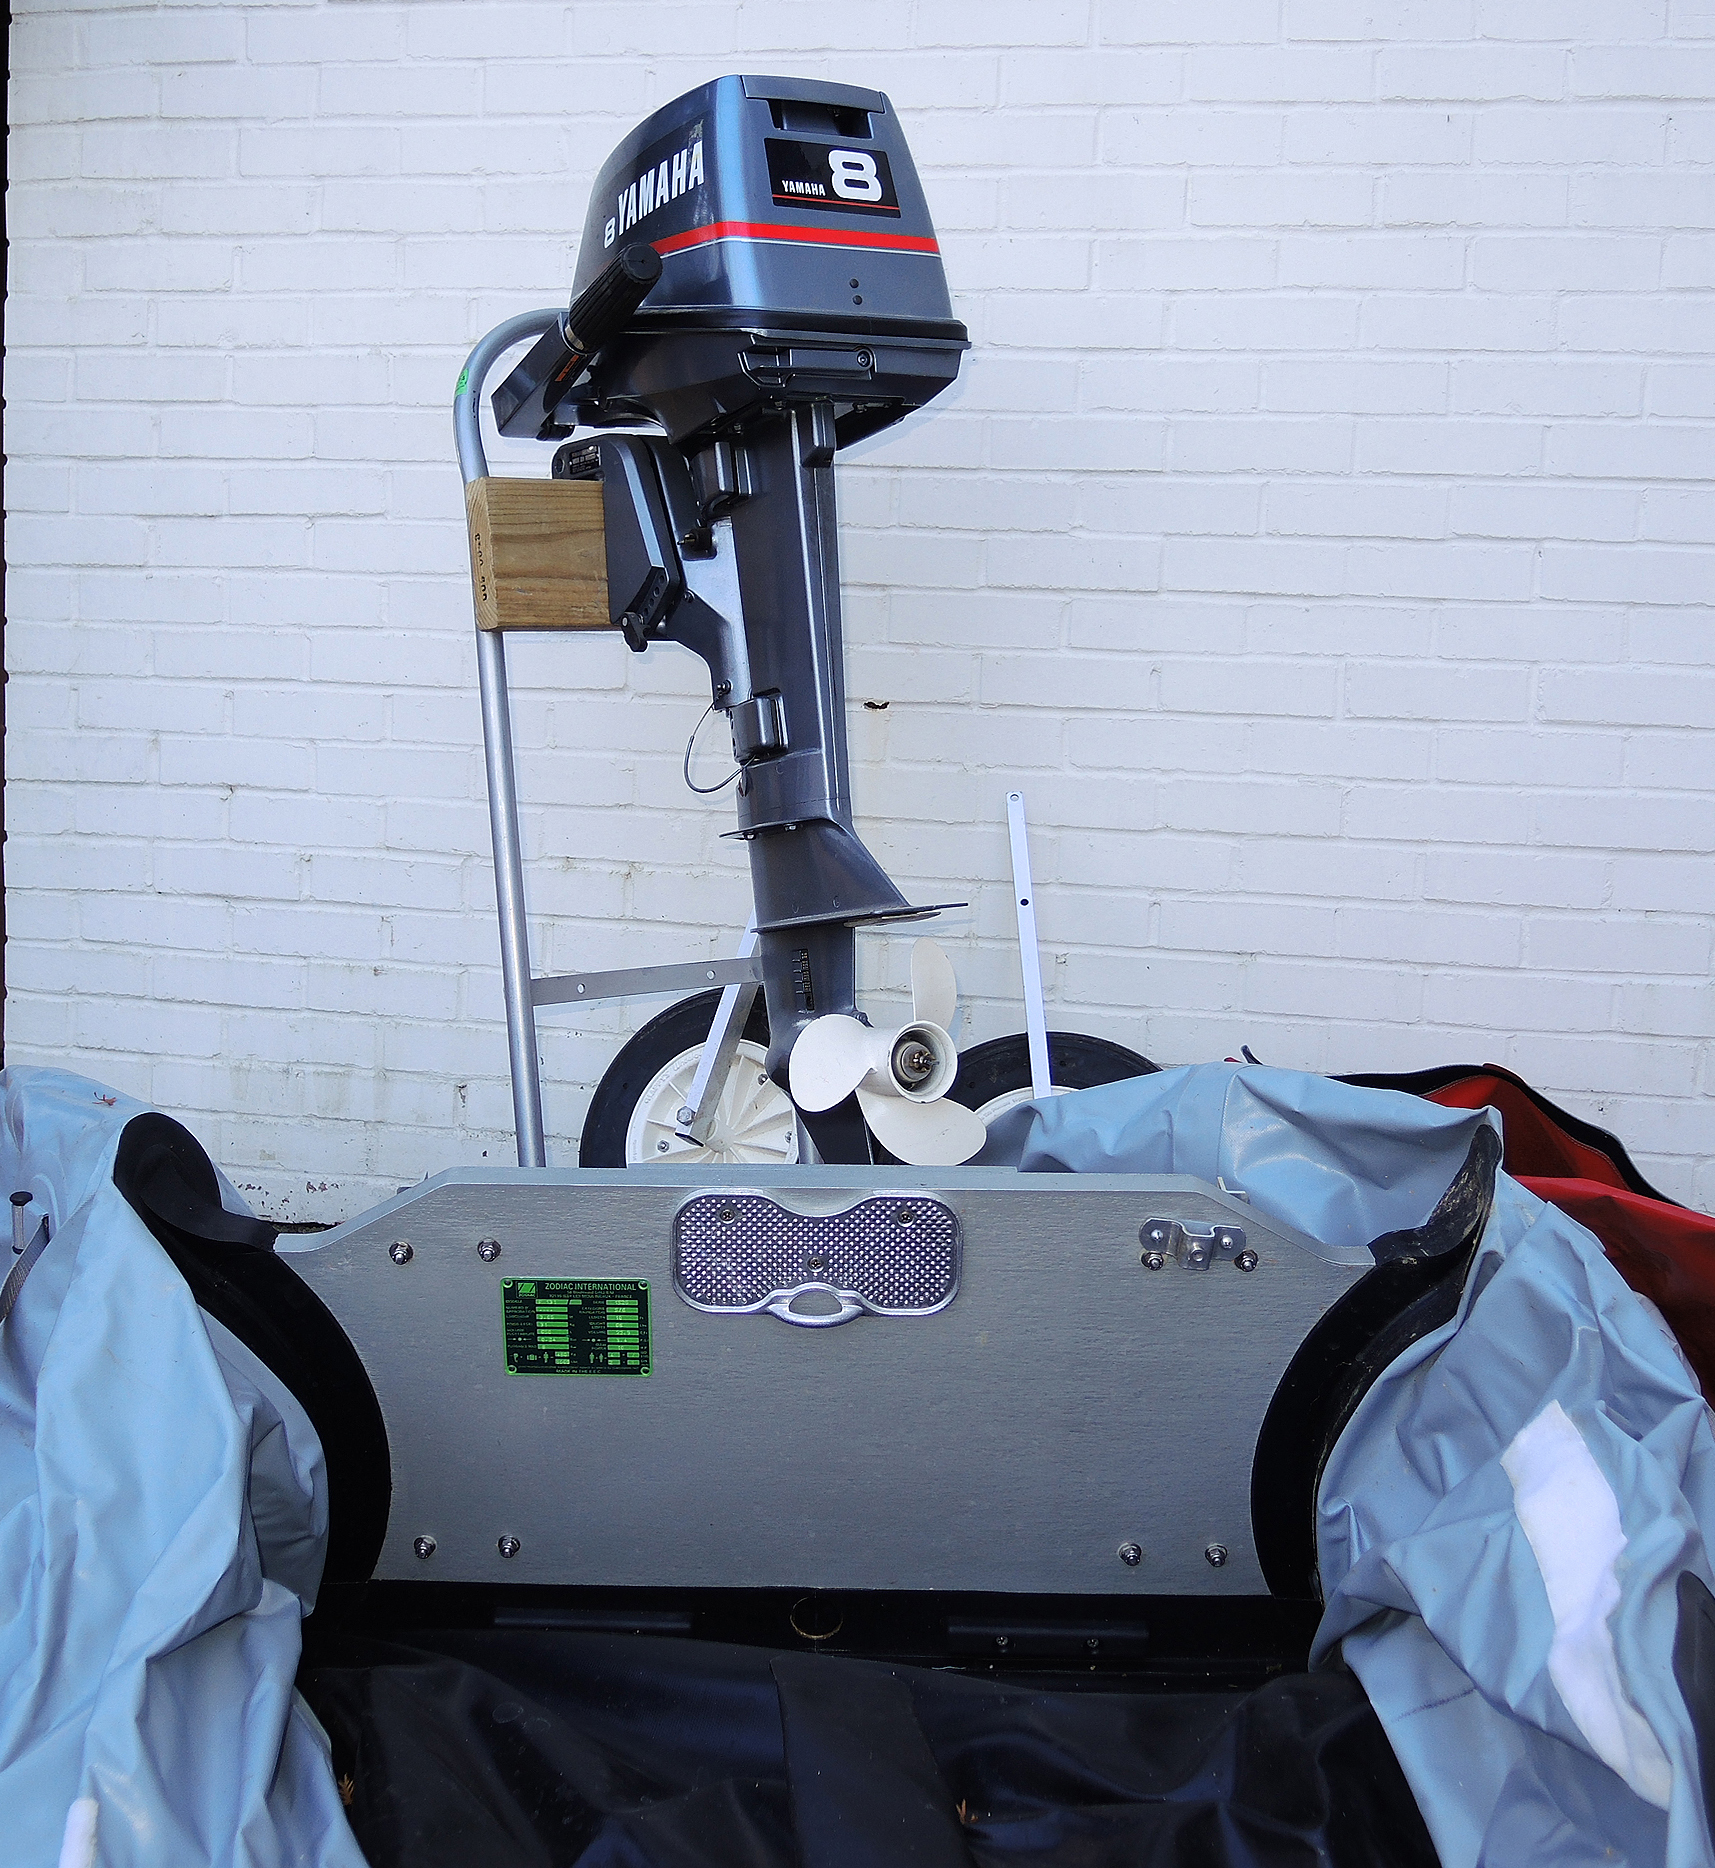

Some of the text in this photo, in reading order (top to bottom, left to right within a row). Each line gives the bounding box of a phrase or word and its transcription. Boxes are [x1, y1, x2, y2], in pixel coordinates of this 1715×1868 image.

[603, 142, 705, 248] 8 YAMAHA
[782, 150, 882, 201] YAMAHA 8
[544, 1282, 637, 1291] ZODIAC INTERNATIONAL
